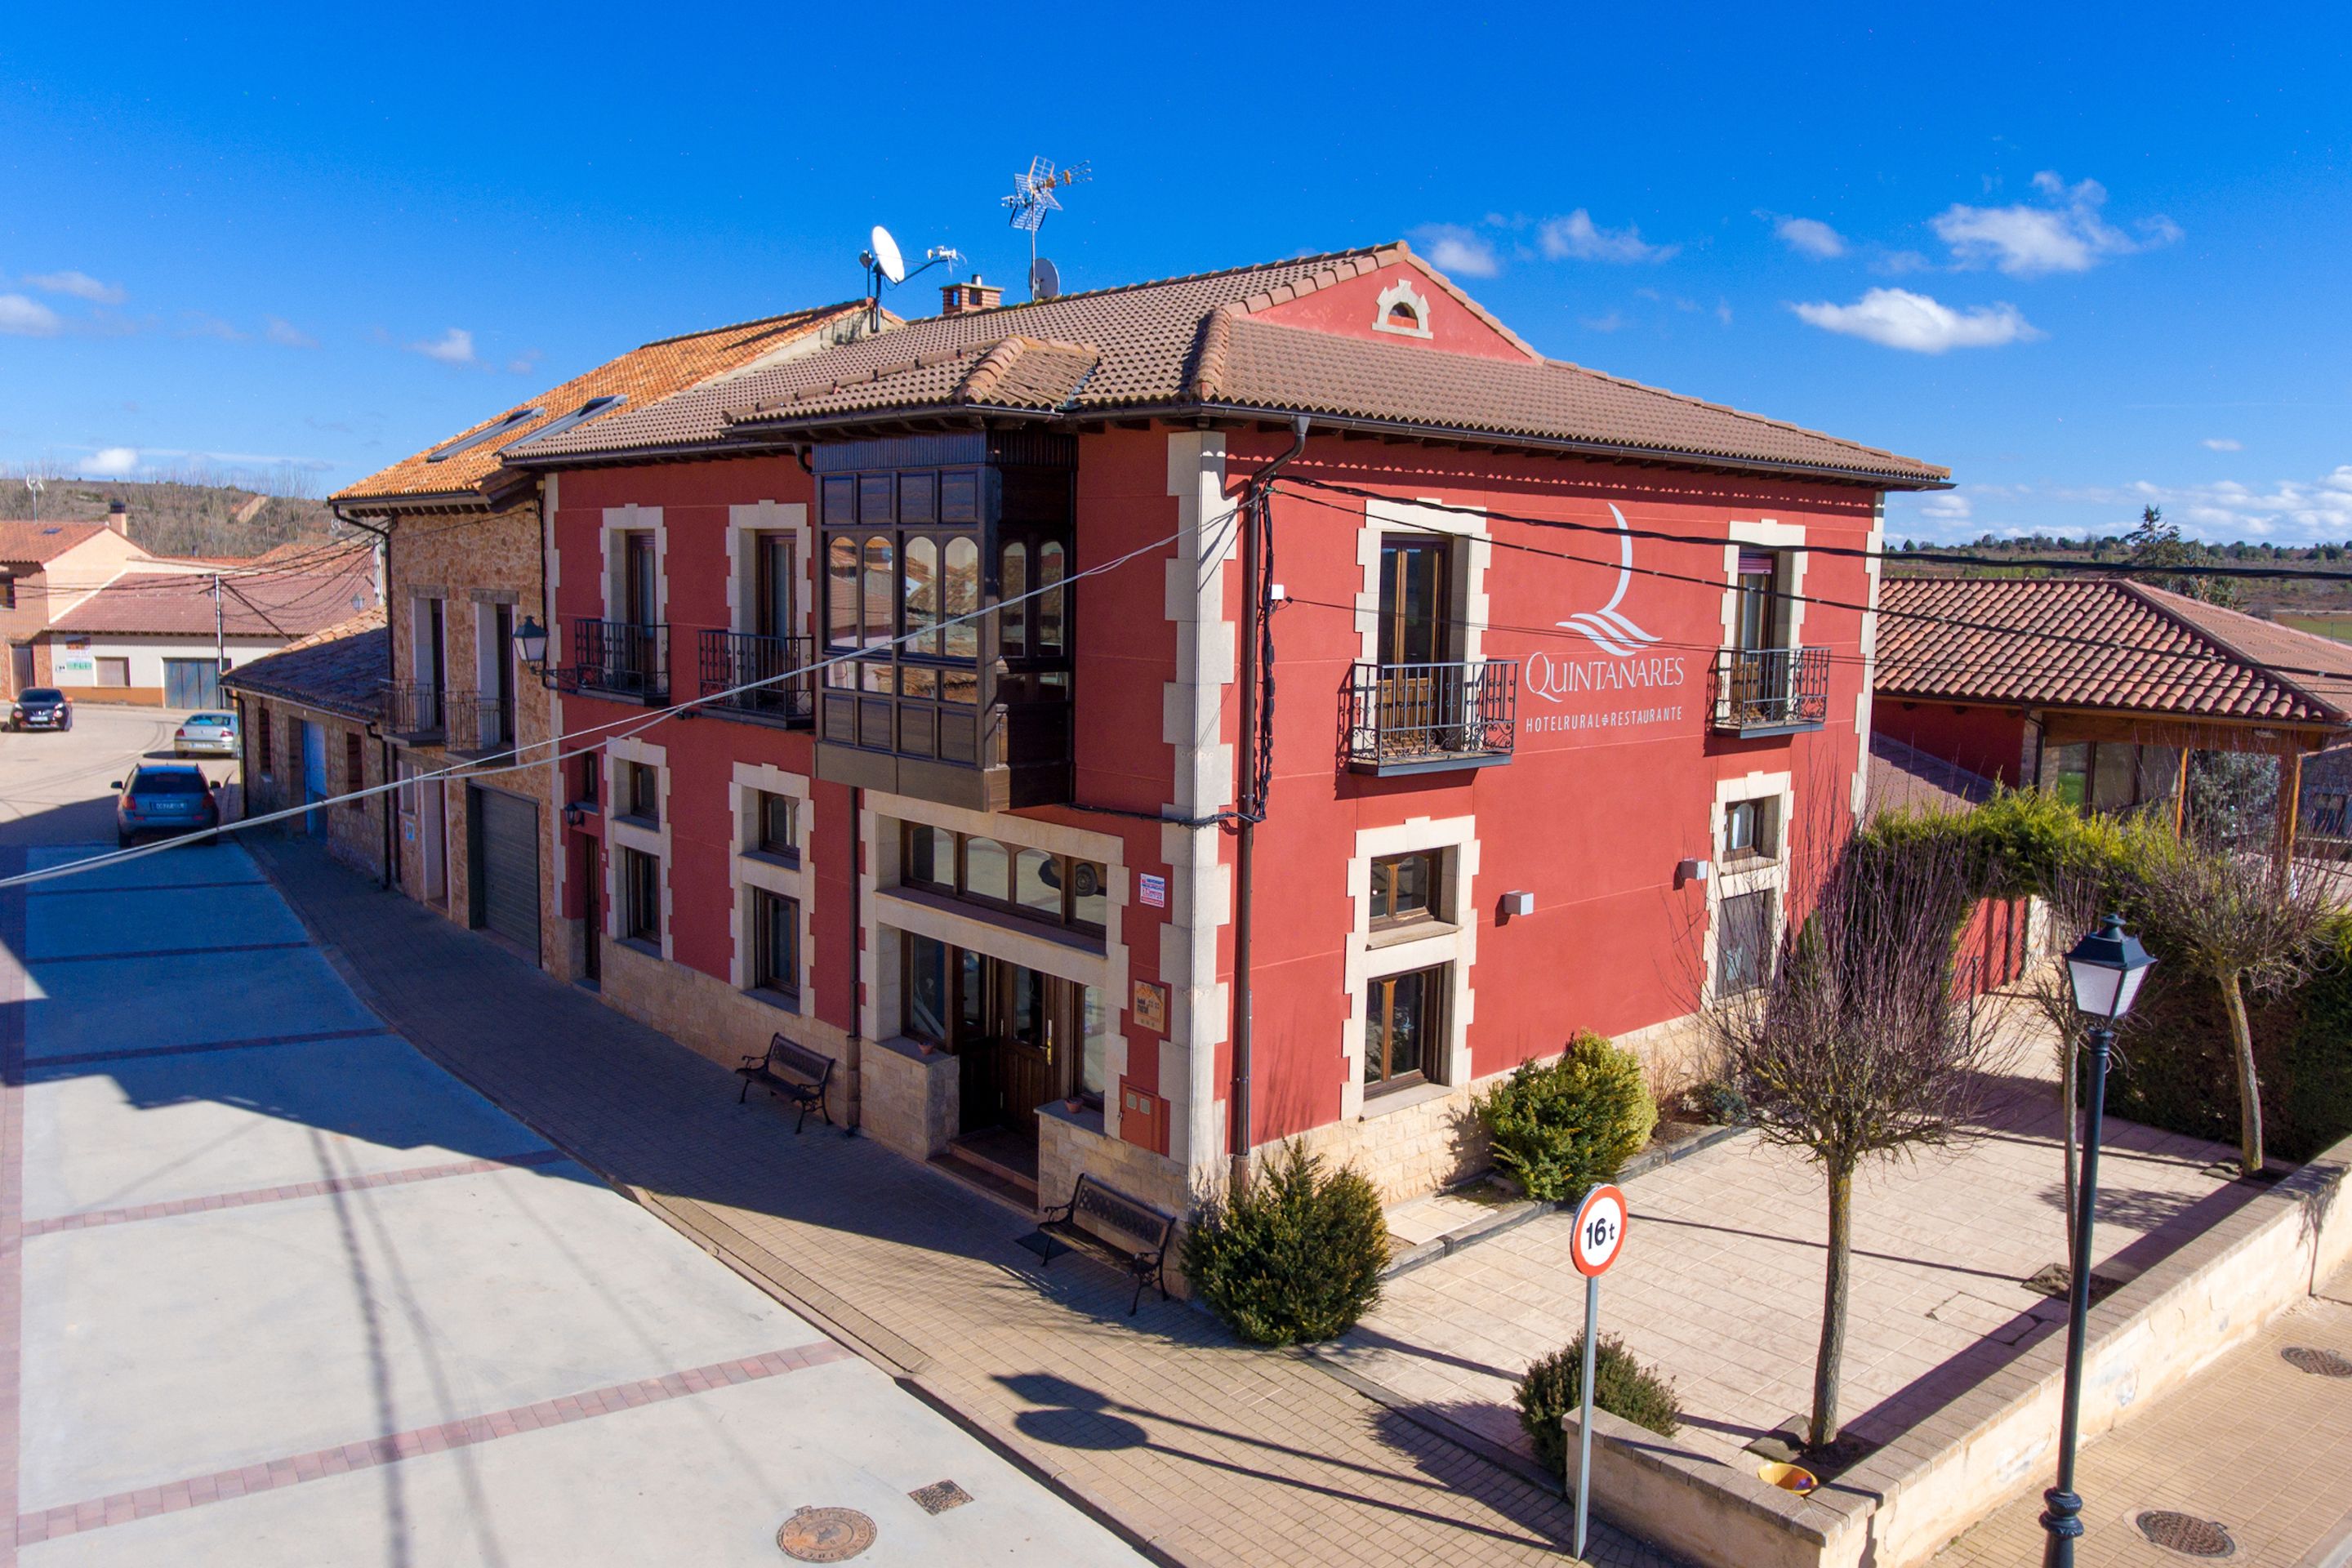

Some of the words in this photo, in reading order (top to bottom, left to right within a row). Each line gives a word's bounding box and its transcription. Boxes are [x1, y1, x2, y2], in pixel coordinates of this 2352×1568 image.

[1525, 651, 1685, 703] QUINTANARES
[1610, 706, 1682, 726] RESTAURANTE
[1586, 1218, 1606, 1250] 16
[1609, 1223, 1615, 1241] t
